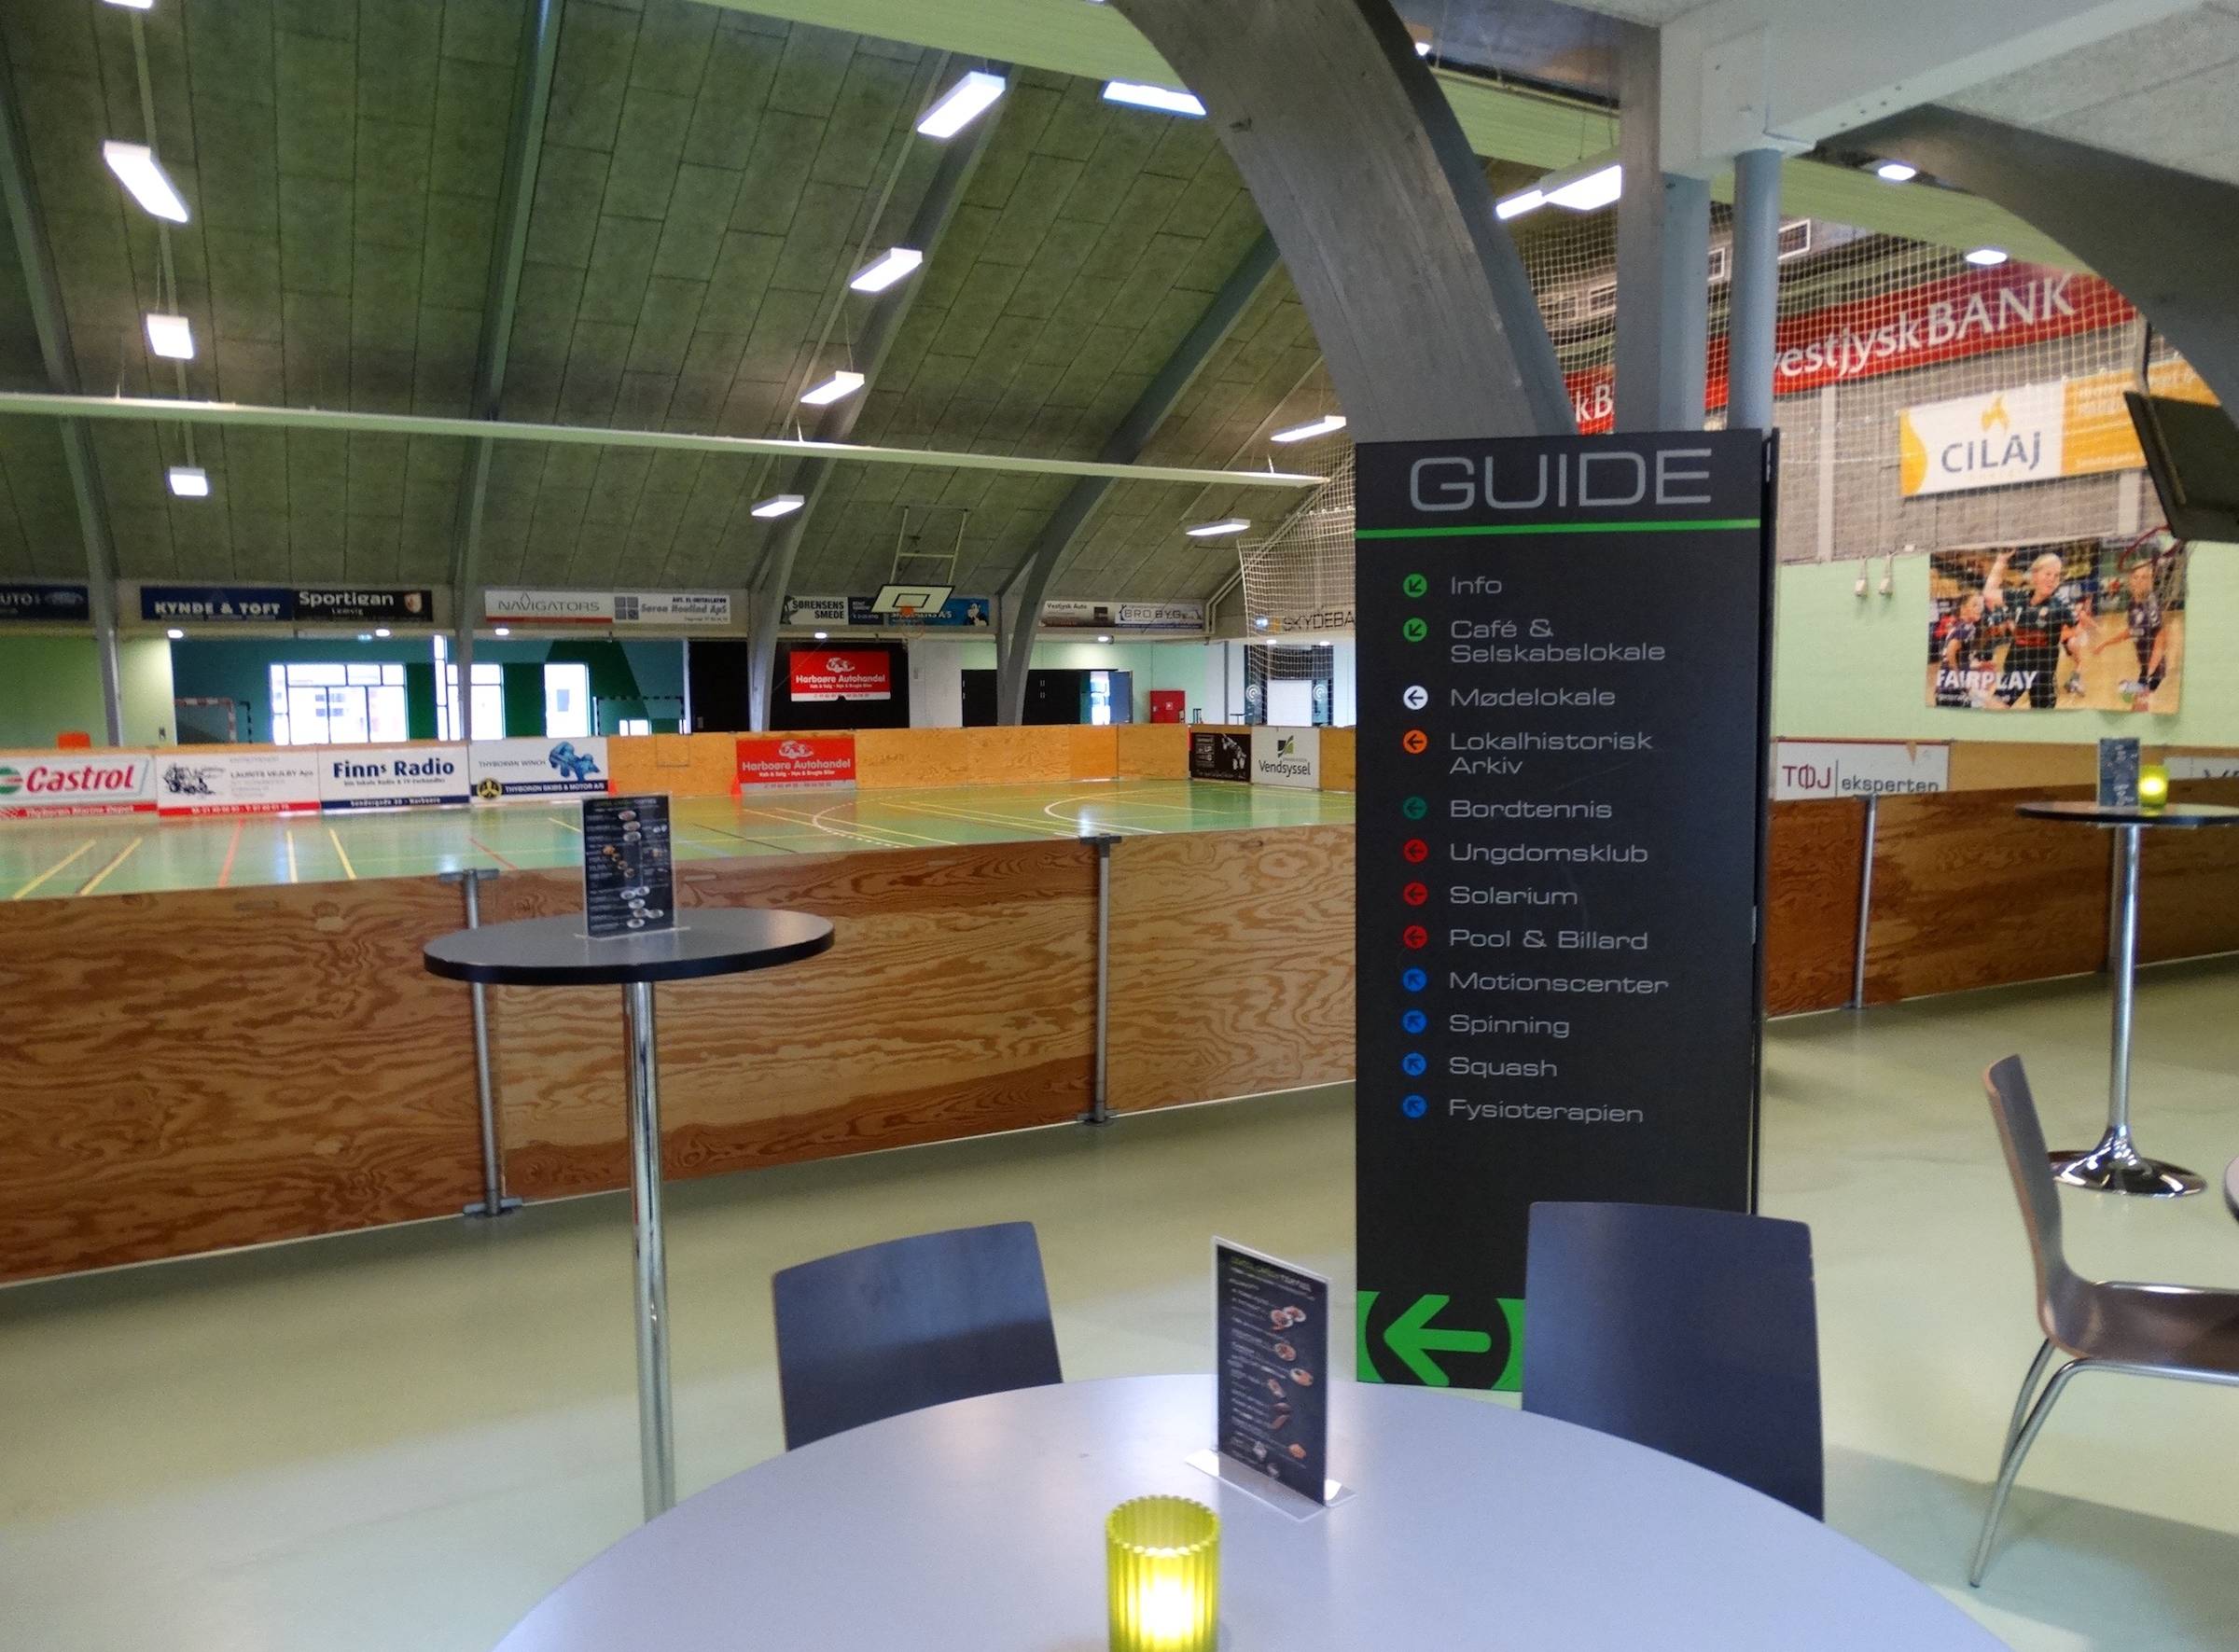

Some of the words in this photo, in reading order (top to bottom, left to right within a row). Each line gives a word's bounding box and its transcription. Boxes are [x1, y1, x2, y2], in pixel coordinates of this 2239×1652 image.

[1941, 431, 2041, 473] CILAJ
[1410, 447, 1712, 511] GUIDE
[1451, 576, 1503, 595] Info
[220, 602, 233, 615] &
[299, 590, 395, 608] Sportigan
[498, 600, 600, 612] NAVIGATORS
[792, 599, 844, 610] SØRENSENS
[814, 610, 844, 619] SMEDE
[1124, 609, 1151, 618] BRO
[1451, 618, 1517, 640] Café
[1529, 618, 1553, 637] &
[1451, 643, 1665, 663] Selskabslokale
[838, 673, 885, 683] Autohandel
[1937, 670, 2038, 691] FAIRPLAY
[1450, 686, 1616, 706] Mødelokale
[1450, 732, 1653, 750] Lokalhistorisk
[394, 757, 455, 776] Radio
[794, 758, 851, 770] Autohandel
[1259, 759, 1312, 778] Vendsyssel
[1450, 756, 1523, 775] Arkiv
[26, 764, 135, 793] Castrol
[1782, 763, 1831, 790] TØJ
[1842, 773, 1940, 793] eksperten
[569, 783, 592, 791] MOTOR
[1450, 799, 1612, 819] Bordtennis
[1450, 842, 1648, 866] Ungdomsklub
[1450, 886, 1578, 906] Solarium
[1450, 928, 1510, 948] Pool
[1523, 929, 1547, 948] &
[1558, 930, 1648, 951] Billard
[1449, 971, 1669, 994] Motionscenter
[1450, 1014, 1570, 1037] Spinning
[1450, 1057, 1558, 1078] Squash
[1449, 1099, 1644, 1125] Fysioterapien
